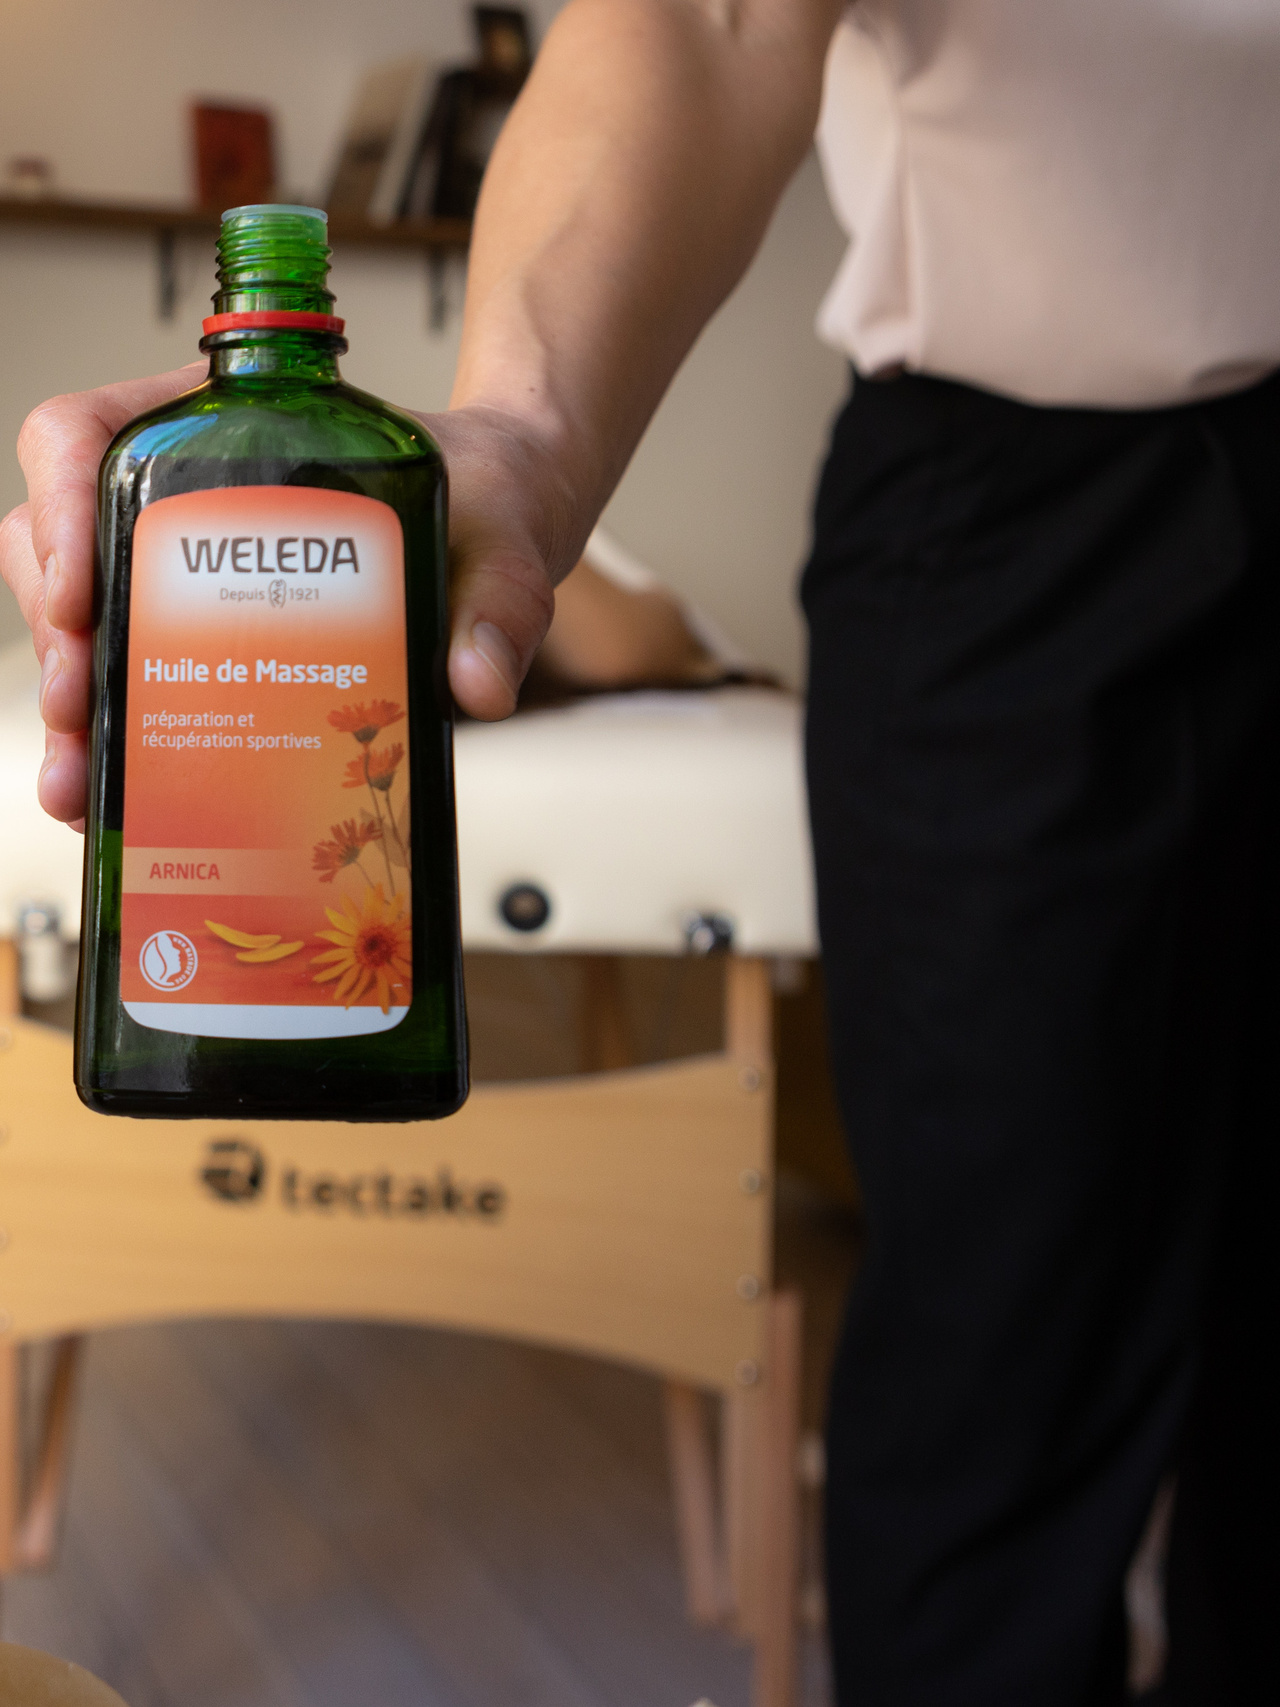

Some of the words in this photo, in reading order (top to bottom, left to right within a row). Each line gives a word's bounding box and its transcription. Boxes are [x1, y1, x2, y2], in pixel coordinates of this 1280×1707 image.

[181, 537, 360, 573] WELEDA
[220, 587, 265, 602] Depuis
[289, 587, 319, 601] 1921
[144, 658, 209, 682] Huile
[216, 658, 248, 682] de
[256, 659, 367, 689] Massage
[143, 711, 234, 729] préparation
[238, 713, 255, 727] et
[143, 731, 243, 750] récupération
[246, 732, 322, 751] sportives
[149, 862, 220, 880] ARNICA
[283, 1165, 506, 1223] tectake
